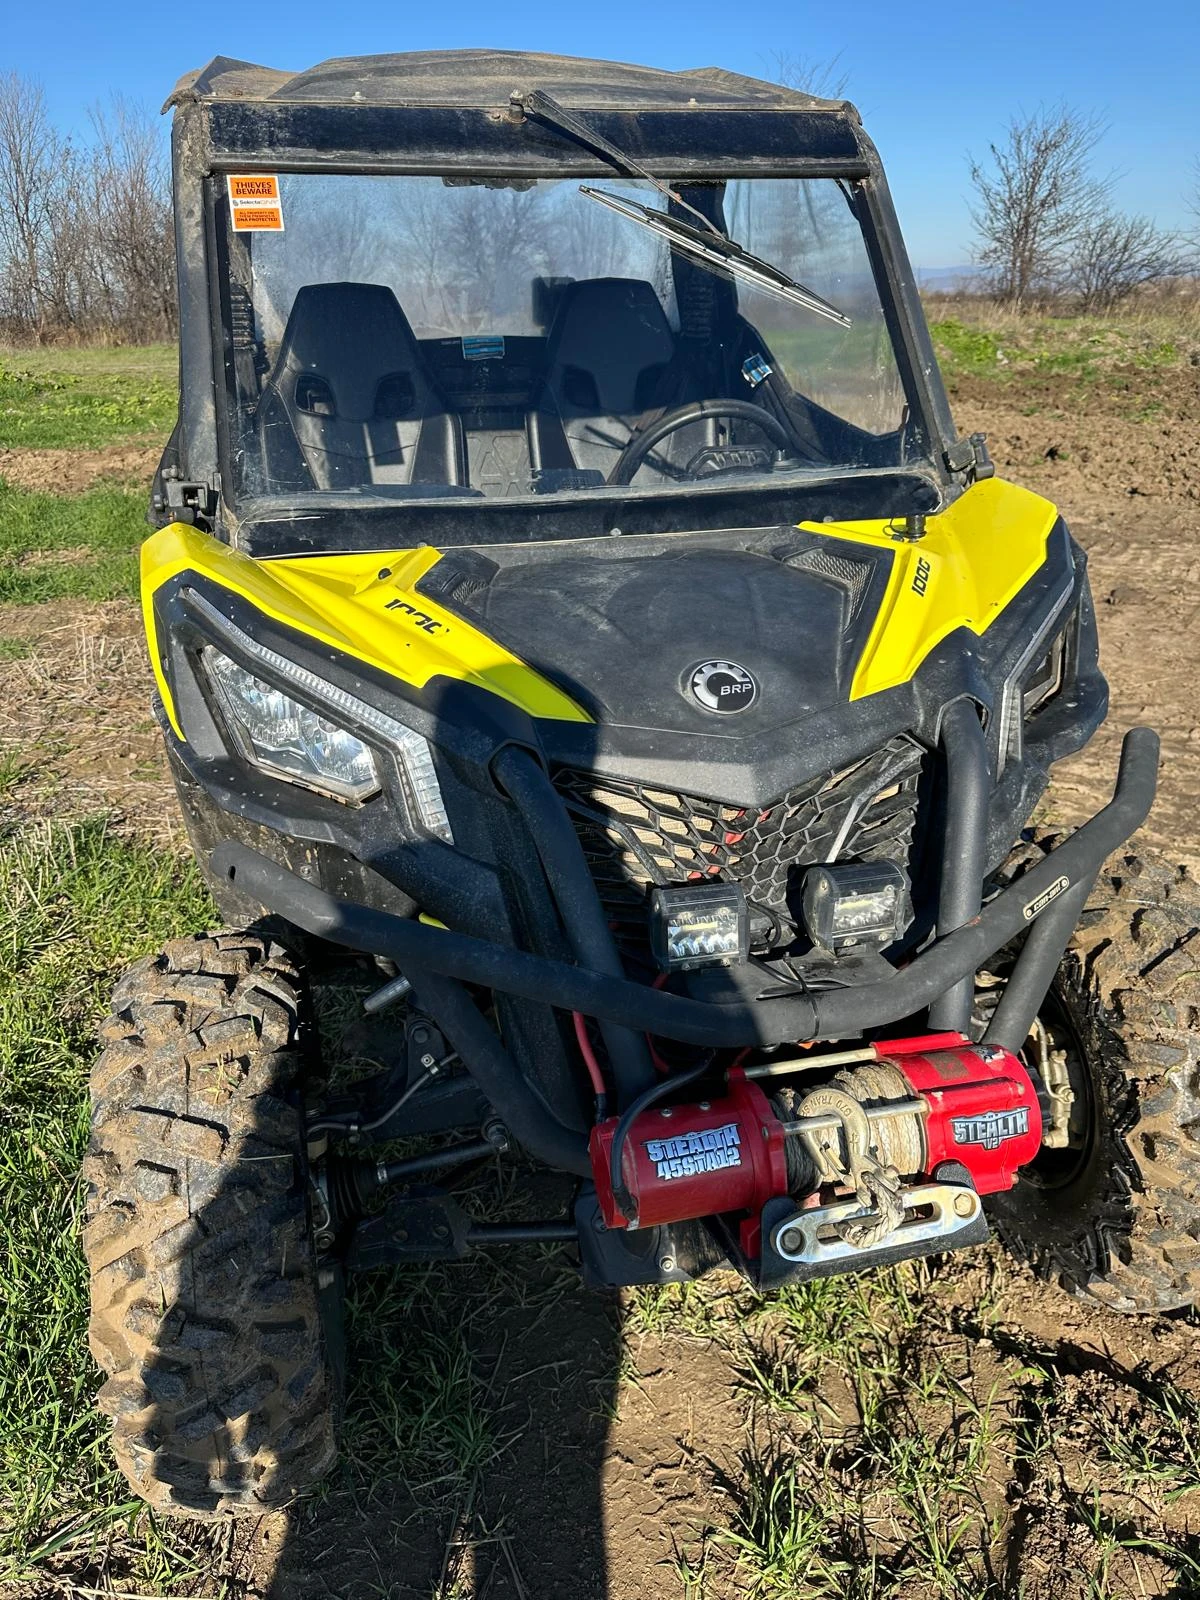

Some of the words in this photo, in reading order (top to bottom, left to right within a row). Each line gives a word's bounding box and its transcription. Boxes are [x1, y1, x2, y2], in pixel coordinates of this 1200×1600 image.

[720, 683, 752, 696] BRP
[953, 1110, 1029, 1143] STEALTH
[646, 1125, 741, 1162] STEALTH
[985, 1136, 1000, 1149] V2
